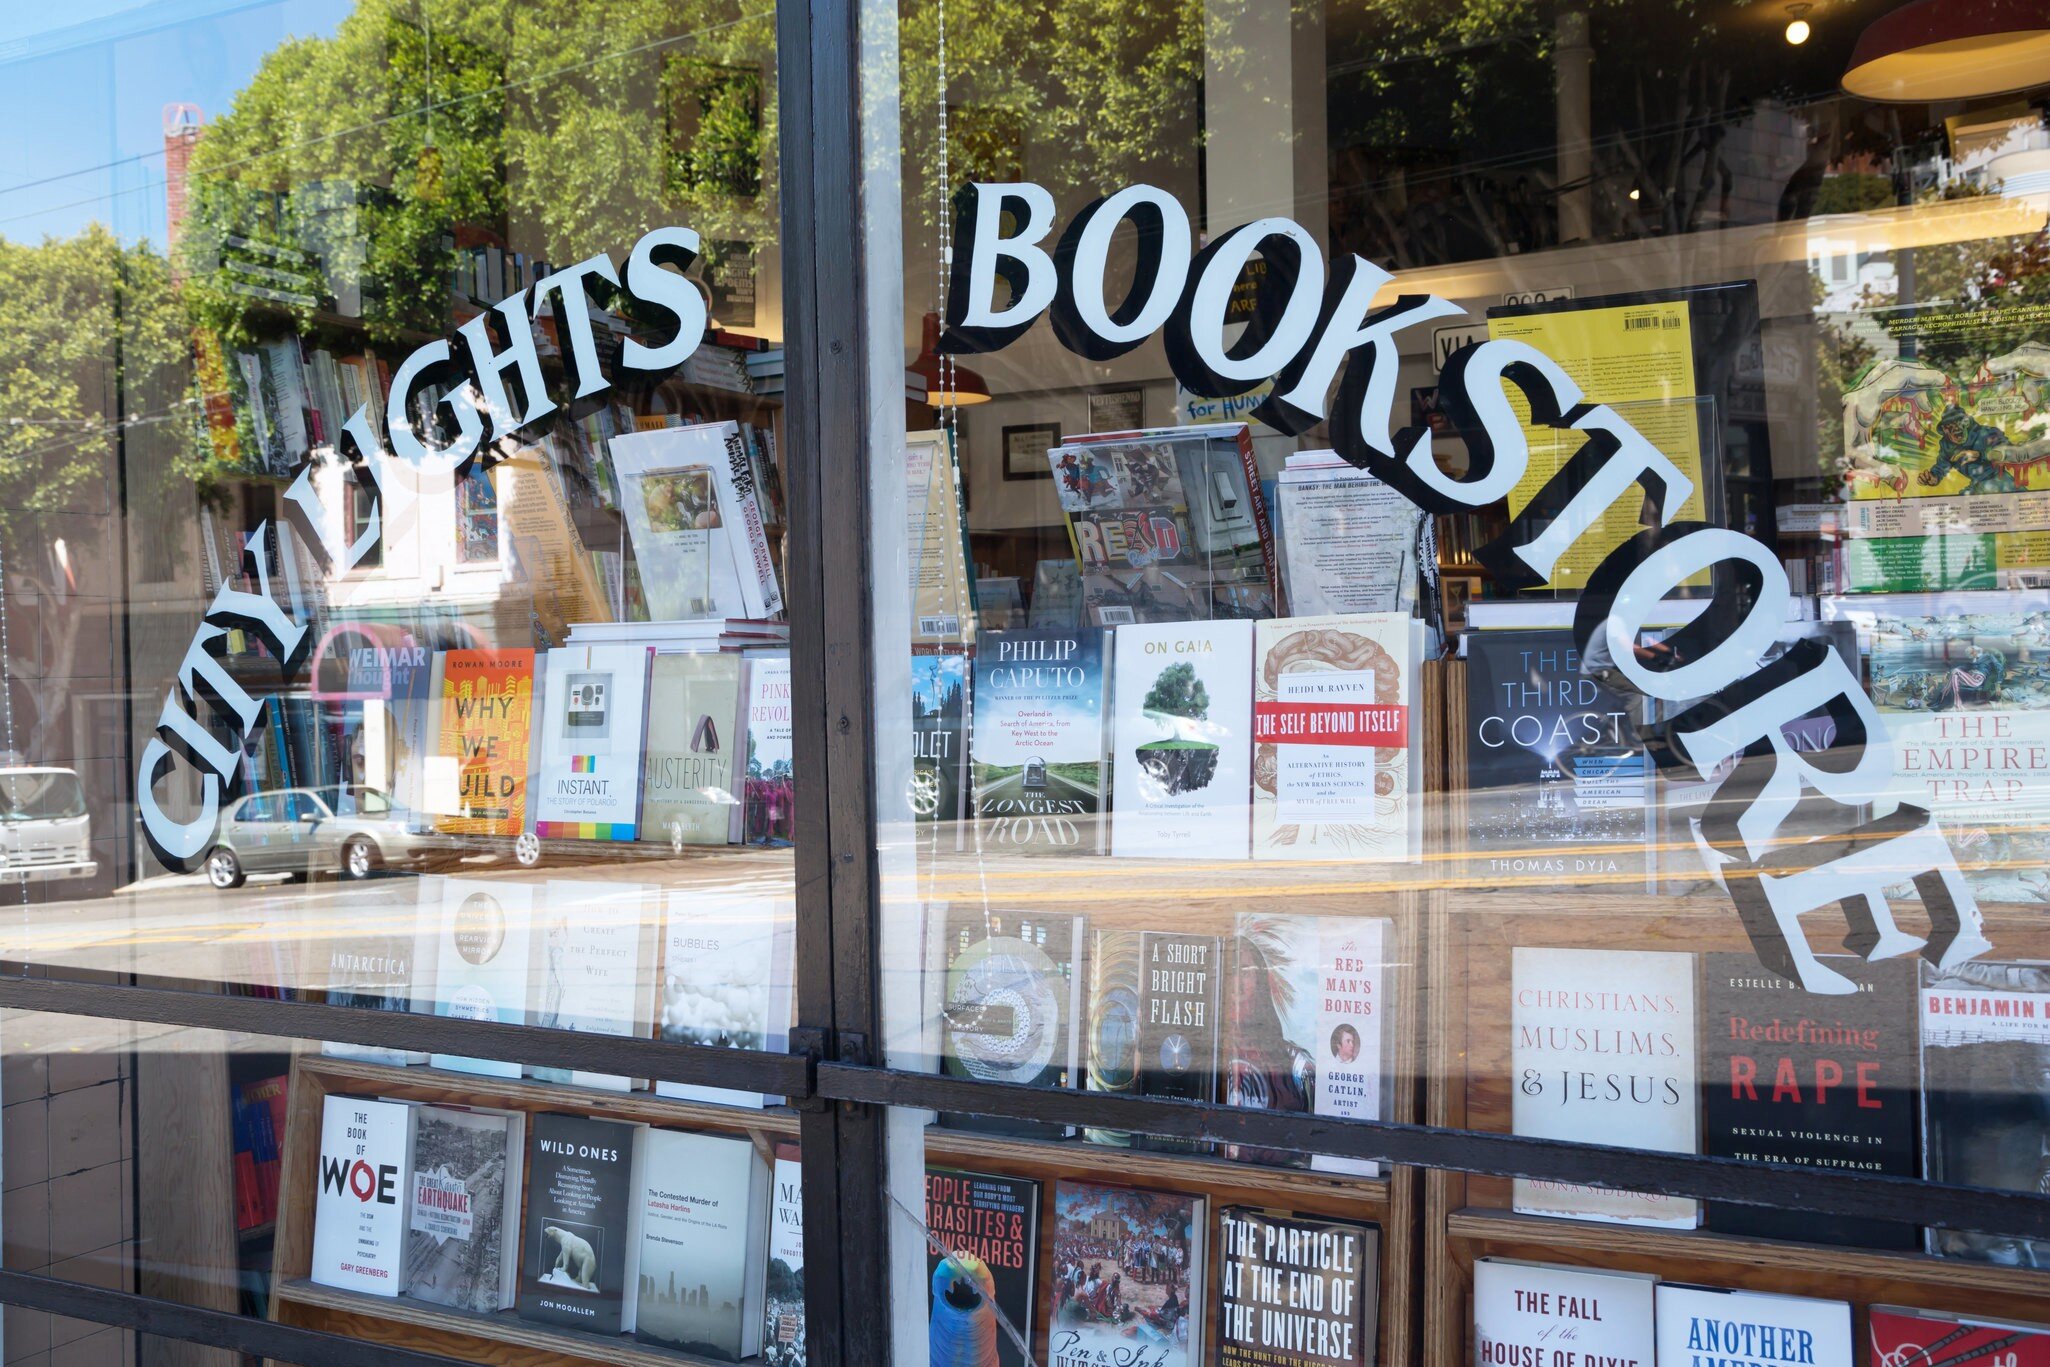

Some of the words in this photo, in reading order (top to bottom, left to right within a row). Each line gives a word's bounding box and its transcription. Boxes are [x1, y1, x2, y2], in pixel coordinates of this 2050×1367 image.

[1187, 401, 1216, 420] for
[1244, 451, 1260, 493] STREET
[1253, 495, 1264, 516] ART
[1259, 518, 1269, 540] AND
[138, 519, 310, 858] CITY
[283, 226, 707, 580] LIGHTS
[743, 506, 756, 545] GEORGE
[753, 547, 764, 587] ORWELL
[749, 500, 762, 538] GEORGE
[758, 541, 771, 579] ORWELL
[963, 182, 1992, 995] BOOKSTORE
[350, 647, 425, 668] WEIMAR
[998, 640, 1077, 662] PHILIP
[1144, 640, 1168, 655] ON
[452, 661, 485, 669] ROWAN
[489, 660, 523, 668] MOORE
[1520, 650, 1577, 673] THE
[990, 667, 1085, 689] CAPUTO
[1288, 684, 1315, 694] HEIDI
[1329, 683, 1365, 693] RAVVEN
[762, 683, 790, 699] PINK
[1501, 680, 1598, 708] THIRD
[455, 697, 514, 719] WHY
[1256, 714, 1277, 736] THE
[1280, 712, 1306, 735] SELF
[1310, 711, 1354, 734] BEYOND
[1359, 709, 1401, 733] ITSELF
[1479, 712, 1626, 748] COAST
[1934, 715, 2013, 739] THE
[462, 736, 499, 758] WE
[1903, 748, 2048, 770] EMPIRE
[645, 757, 727, 790] AUSTERITY
[459, 774, 515, 798] UILD
[1927, 779, 2023, 801] TRAP
[980, 799, 1089, 815] LONGEST
[986, 816, 1081, 846] ROAD
[1157, 830, 1171, 838] Toby
[1490, 859, 1565, 872] THOMAS
[1576, 859, 1618, 873] DYJA
[673, 937, 720, 950] BUBBLES
[1152, 943, 1159, 962] A
[1167, 943, 1207, 965] SHORT
[331, 953, 406, 975] ANTARCTICA
[1335, 958, 1363, 972] RED
[1152, 969, 1207, 995] BRIGHT
[1326, 977, 1371, 994] MAN'S
[1730, 978, 1782, 989] ESTELLE
[948, 1004, 984, 1012] SURFACES
[1150, 998, 1205, 1027] FLASH
[1325, 998, 1371, 1015] BONES
[1929, 996, 2035, 1018] BENJAMIN
[1730, 1016, 1879, 1050] Redefining
[1328, 1072, 1364, 1083] GEORGE
[1521, 1069, 1543, 1096] &
[1561, 1070, 1680, 1106] JESUS
[1730, 1055, 1883, 1109] RAPE
[1328, 1085, 1367, 1097] CATLIN,
[1333, 1099, 1358, 1108] ARTIST
[354, 1113, 368, 1124] THE
[347, 1128, 367, 1140] BOOK
[1732, 1127, 1783, 1138] SEXUAL
[1791, 1130, 1859, 1143] VIOLENCE
[1868, 1136, 1883, 1145] IN
[356, 1145, 366, 1156] OF
[540, 1139, 575, 1155] WILD
[580, 1145, 618, 1162] ONES
[1734, 1152, 1758, 1161] THE
[1764, 1154, 1788, 1164] ERA
[1795, 1156, 1811, 1165] OF
[1816, 1158, 1883, 1171] SUFFRAGE
[322, 1155, 398, 1205] WOE
[974, 1181, 997, 1191] LEARNING
[997, 1184, 1011, 1194] FROM
[418, 1187, 468, 1213] EARTHQUAKE
[648, 1189, 658, 1197] The
[660, 1191, 688, 1202] Contested
[690, 1196, 710, 1205] Murder
[648, 1199, 669, 1209] Latasha
[671, 1203, 691, 1213] Harlins
[974, 1190, 984, 1199] OUR
[984, 1192, 1002, 1201] BODY'S
[1002, 1194, 1016, 1203] MOST
[974, 1199, 1000, 1211] TERRIFYING
[1001, 1203, 1025, 1213] INVADERS
[1010, 1214, 1023, 1241] &
[646, 1234, 660, 1242] Brenda
[661, 1236, 684, 1246] Stevenson
[1227, 1219, 1257, 1259] THE
[1265, 1223, 1354, 1274] PARTICLE
[341, 1262, 354, 1272] GARY
[356, 1265, 388, 1278] GREENBERG
[1224, 1261, 1242, 1298] AT
[1251, 1264, 1281, 1306] THE
[1289, 1269, 1322, 1312] END
[1331, 1276, 1354, 1317] OF
[540, 1300, 554, 1309] JON
[556, 1303, 595, 1316] MOOALLEM
[1514, 1290, 1550, 1315] THE
[1557, 1295, 1602, 1322] FALL
[1224, 1303, 1254, 1343] THE
[1262, 1309, 1354, 1361] UNIVERSE
[1537, 1326, 1555, 1342] of
[1558, 1325, 1578, 1341] the
[1687, 1317, 1814, 1365] ANOTHER
[1051, 1330, 1092, 1359] Pen
[1097, 1350, 1108, 1363] &
[1113, 1345, 1169, 1367] Ink
[1223, 1345, 1237, 1355] HOW
[1240, 1348, 1251, 1359] THE
[1253, 1350, 1271, 1363] HUNT
[1273, 1352, 1286, 1365] FOR
[1289, 1355, 1301, 1367] THE
[1481, 1340, 1545, 1367] HOUSE
[1553, 1350, 1576, 1367] OF
